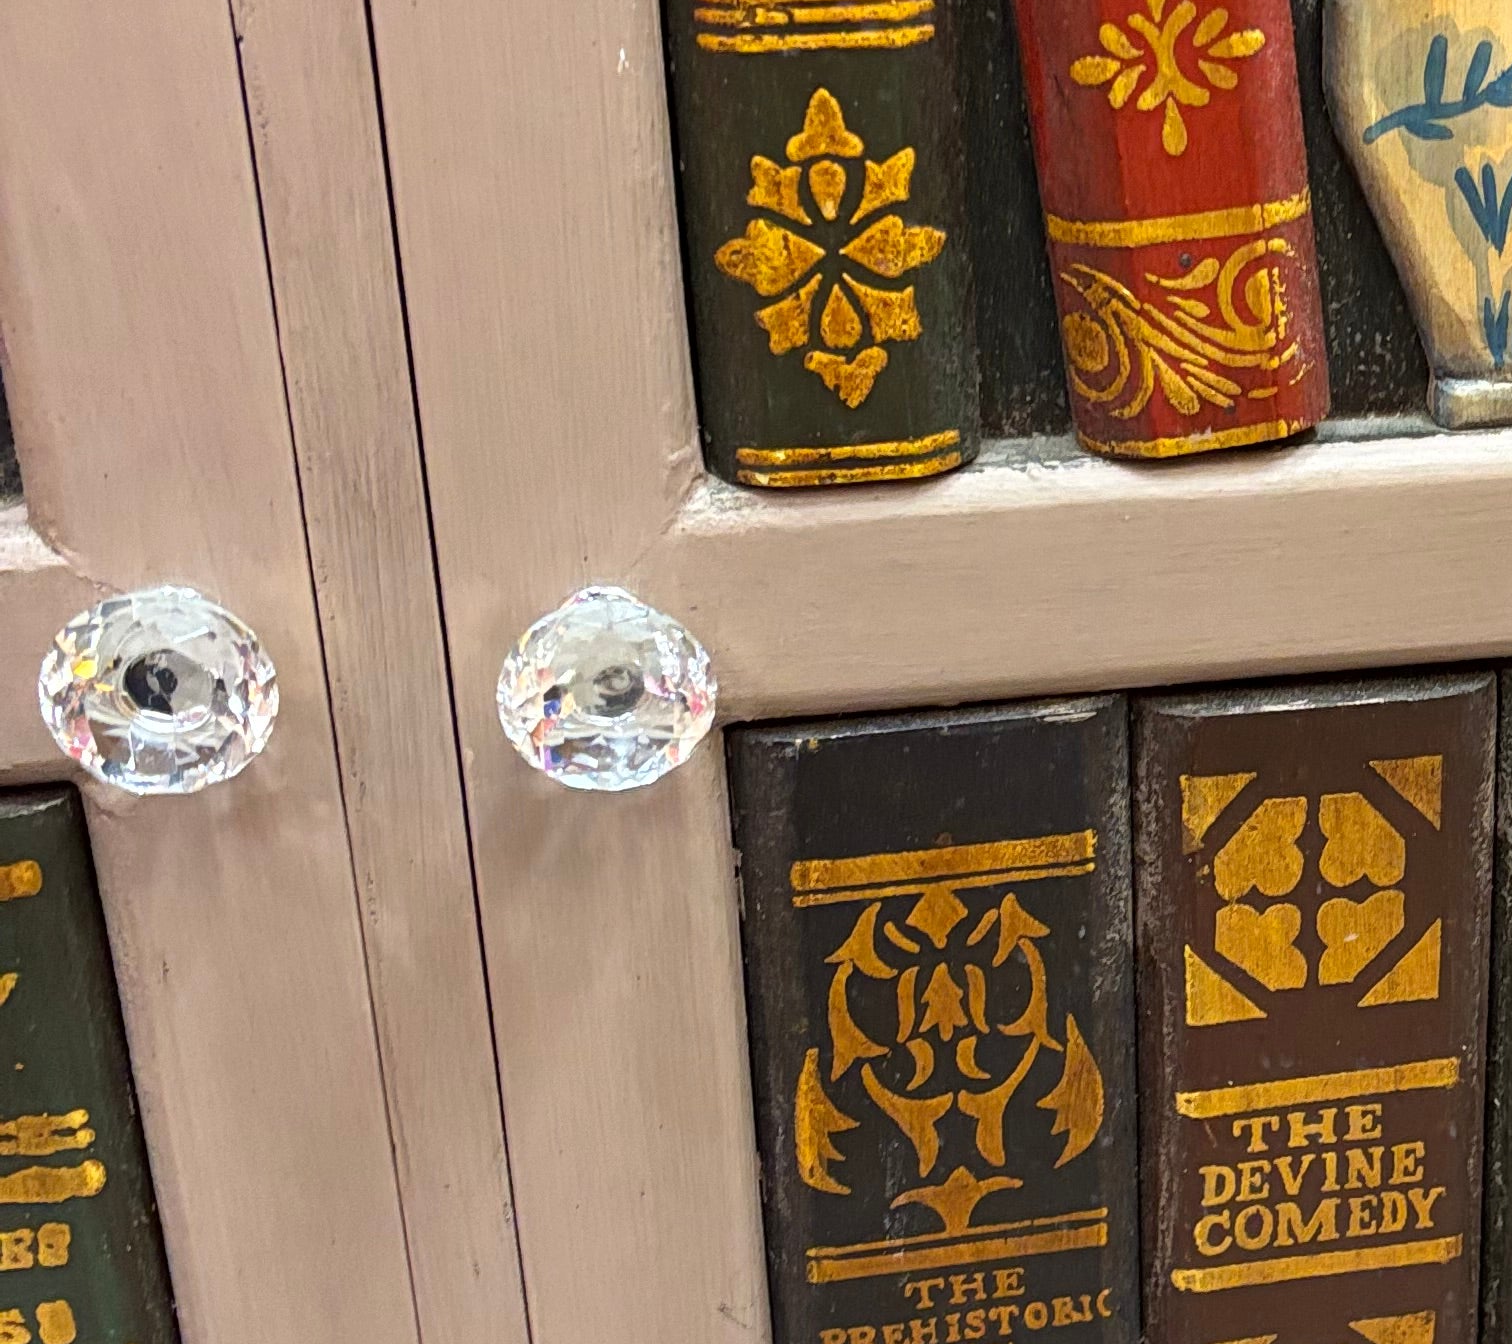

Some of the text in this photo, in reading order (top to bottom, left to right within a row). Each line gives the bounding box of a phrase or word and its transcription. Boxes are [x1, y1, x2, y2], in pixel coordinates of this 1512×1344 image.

[1232, 1103, 1382, 1153] THE
[1199, 1141, 1425, 1207] DEVINE
[1193, 1186, 1446, 1256] COMEDY
[904, 1267, 1026, 1310] THE
